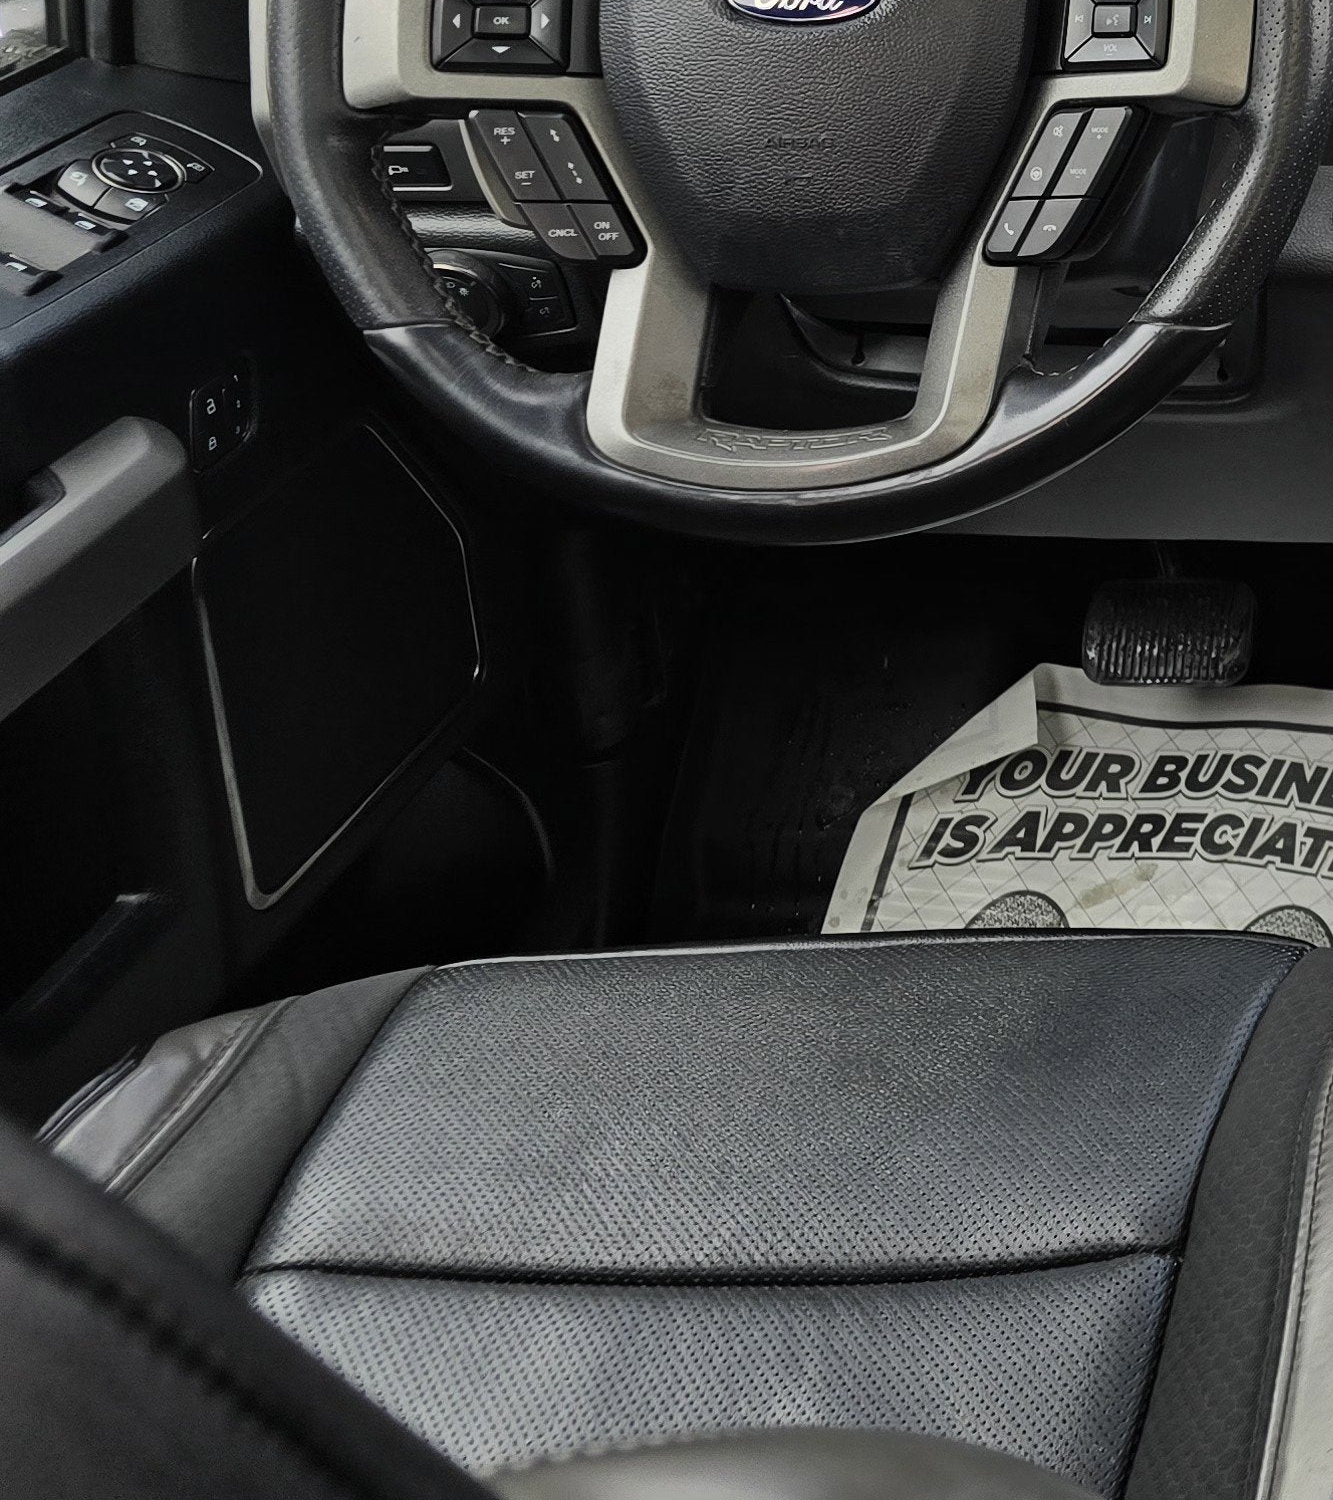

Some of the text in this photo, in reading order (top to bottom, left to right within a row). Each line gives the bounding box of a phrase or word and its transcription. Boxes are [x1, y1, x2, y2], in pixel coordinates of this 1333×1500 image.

[492, 16, 510, 25] OK
[494, 127, 515, 135] RES
[514, 170, 536, 179] SET
[593, 222, 610, 230] ON
[548, 229, 578, 237] CNCL
[598, 232, 619, 241] OFF
[957, 748, 1140, 800] YOUR
[911, 809, 994, 867] IS
